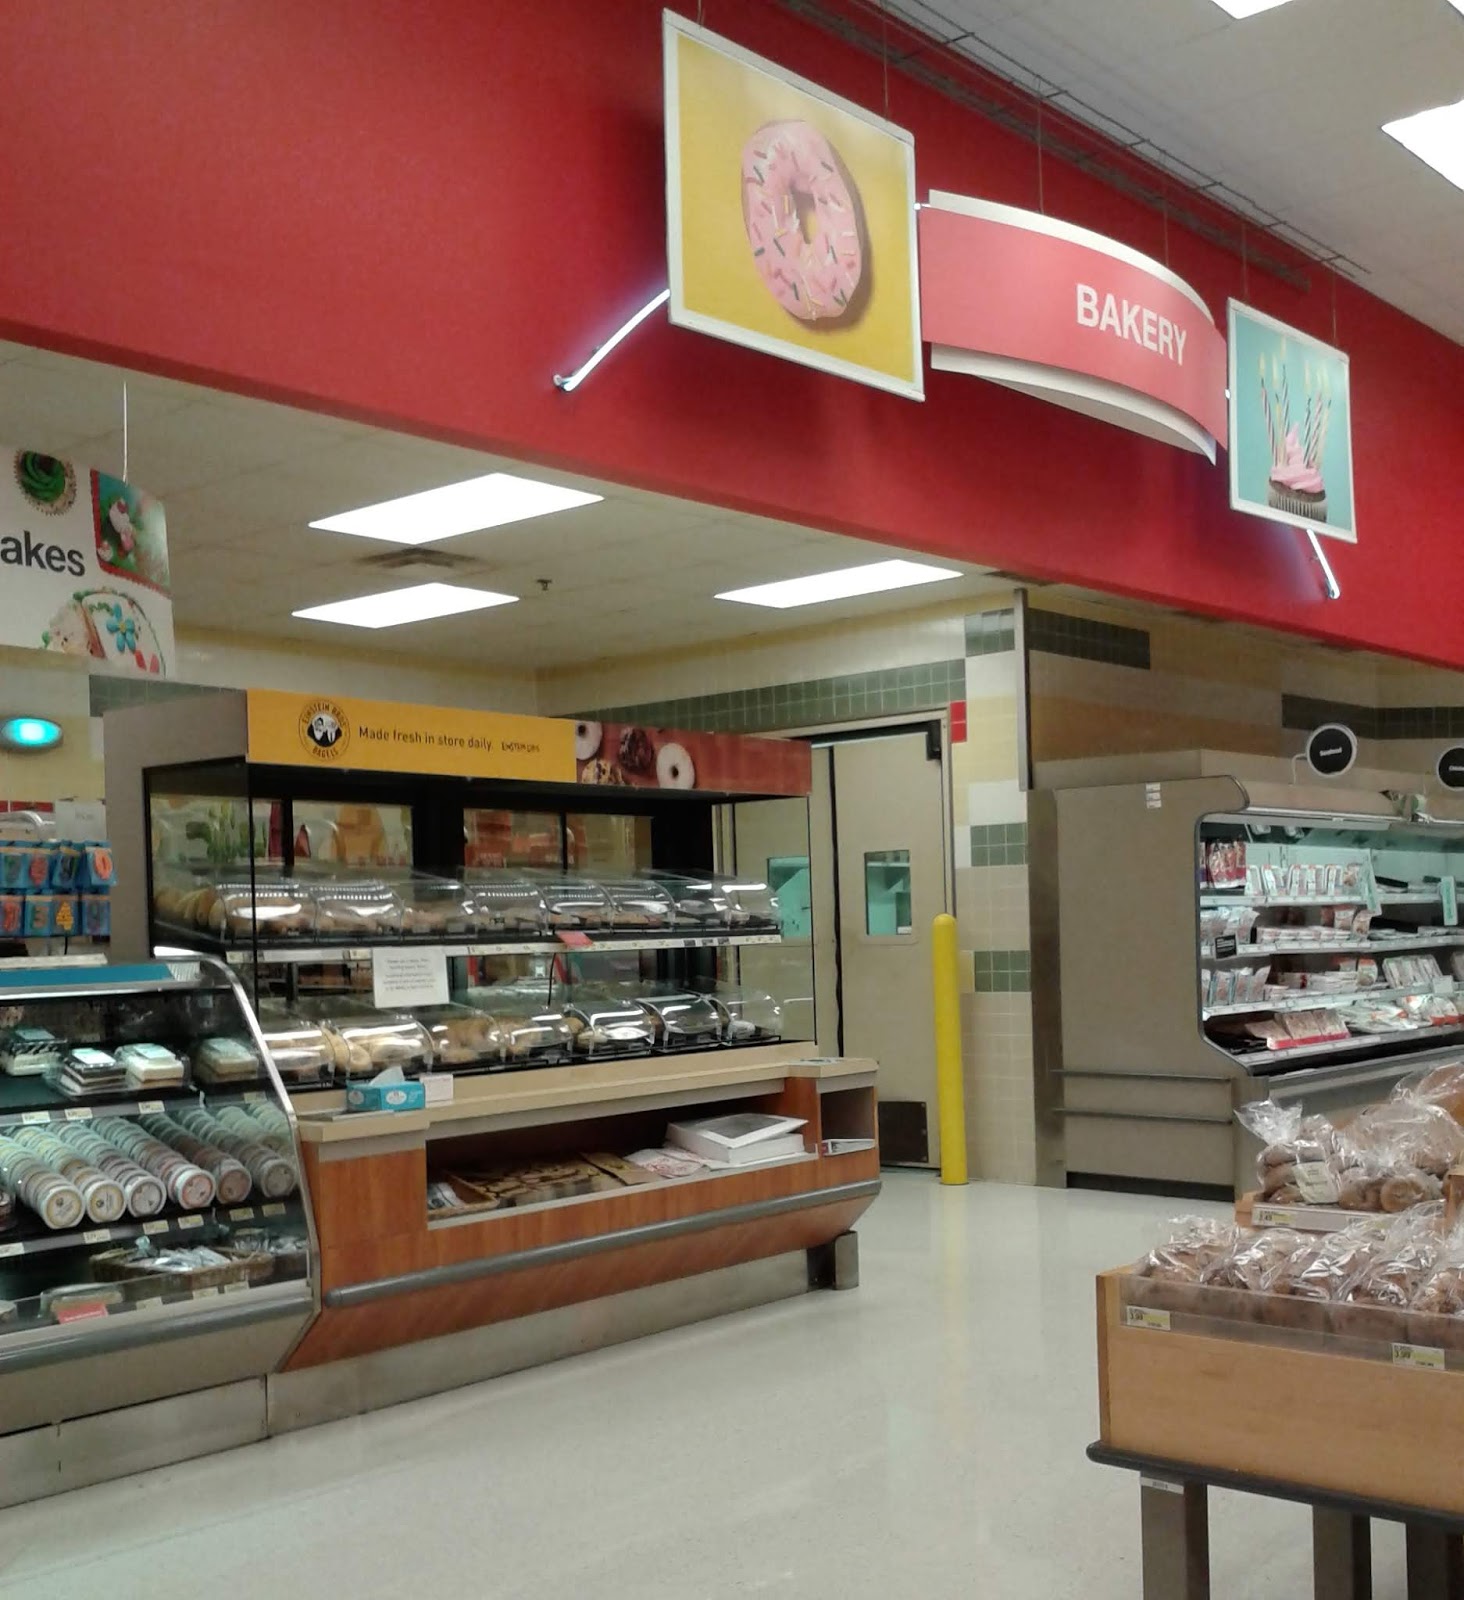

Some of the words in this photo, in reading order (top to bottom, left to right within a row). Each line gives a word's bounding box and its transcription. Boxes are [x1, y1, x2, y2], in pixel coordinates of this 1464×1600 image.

[1076, 282, 1188, 366] BAKERY
[0, 529, 86, 577] akes
[359, 726, 389, 741] Made
[393, 729, 422, 744] fresh
[425, 732, 435, 744] in
[438, 734, 465, 747] store
